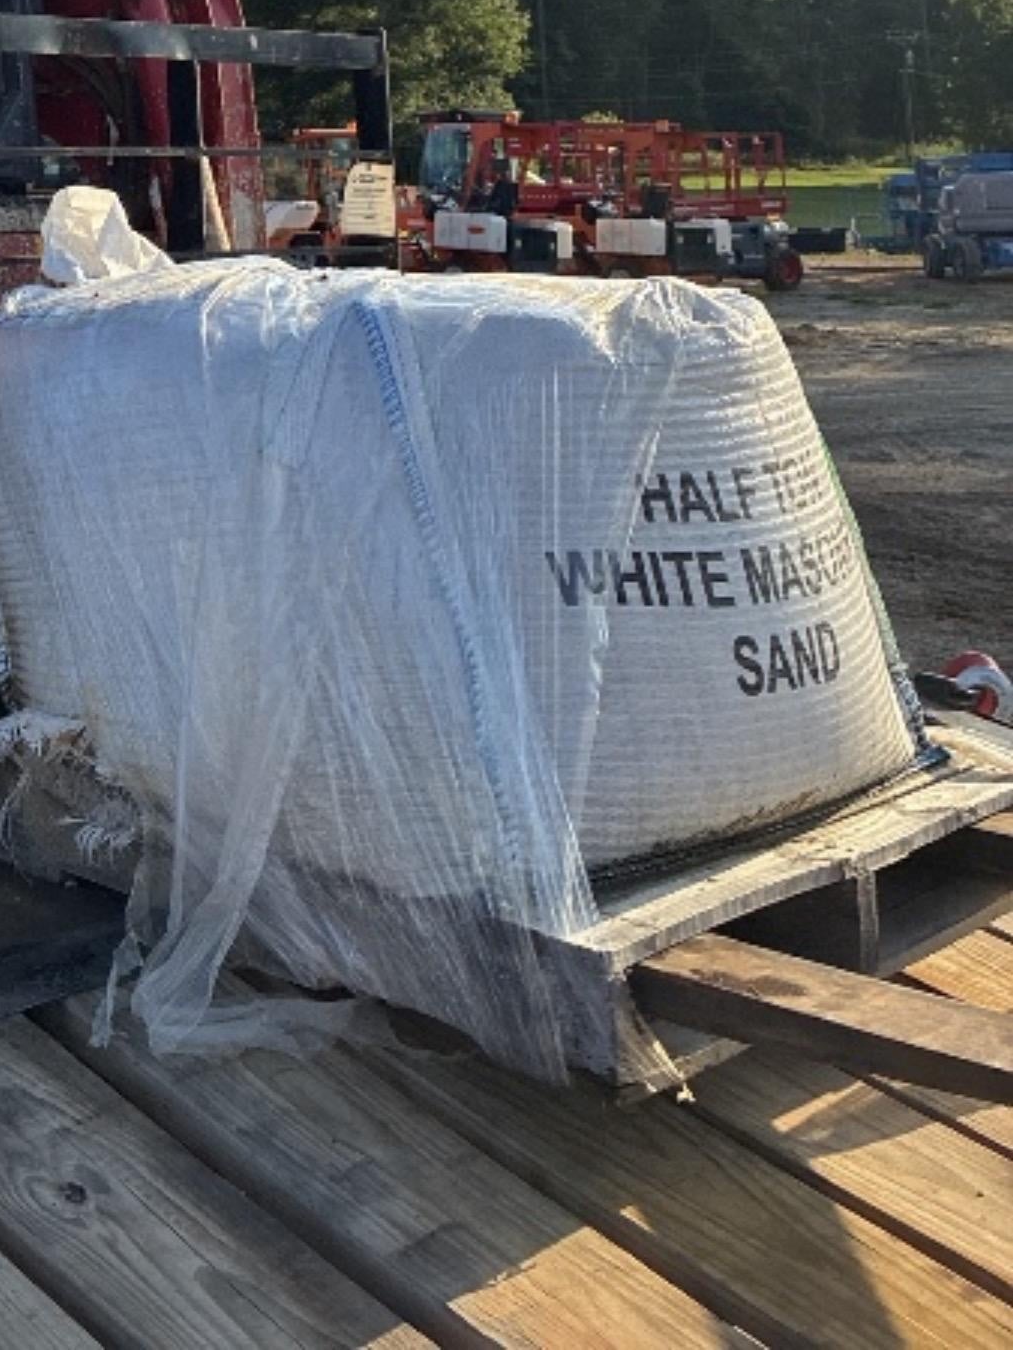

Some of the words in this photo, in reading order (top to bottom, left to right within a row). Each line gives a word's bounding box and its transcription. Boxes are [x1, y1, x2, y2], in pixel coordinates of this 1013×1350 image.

[636, 467, 756, 523] HALF
[545, 550, 736, 607] WHITE
[733, 620, 840, 697] SAND
